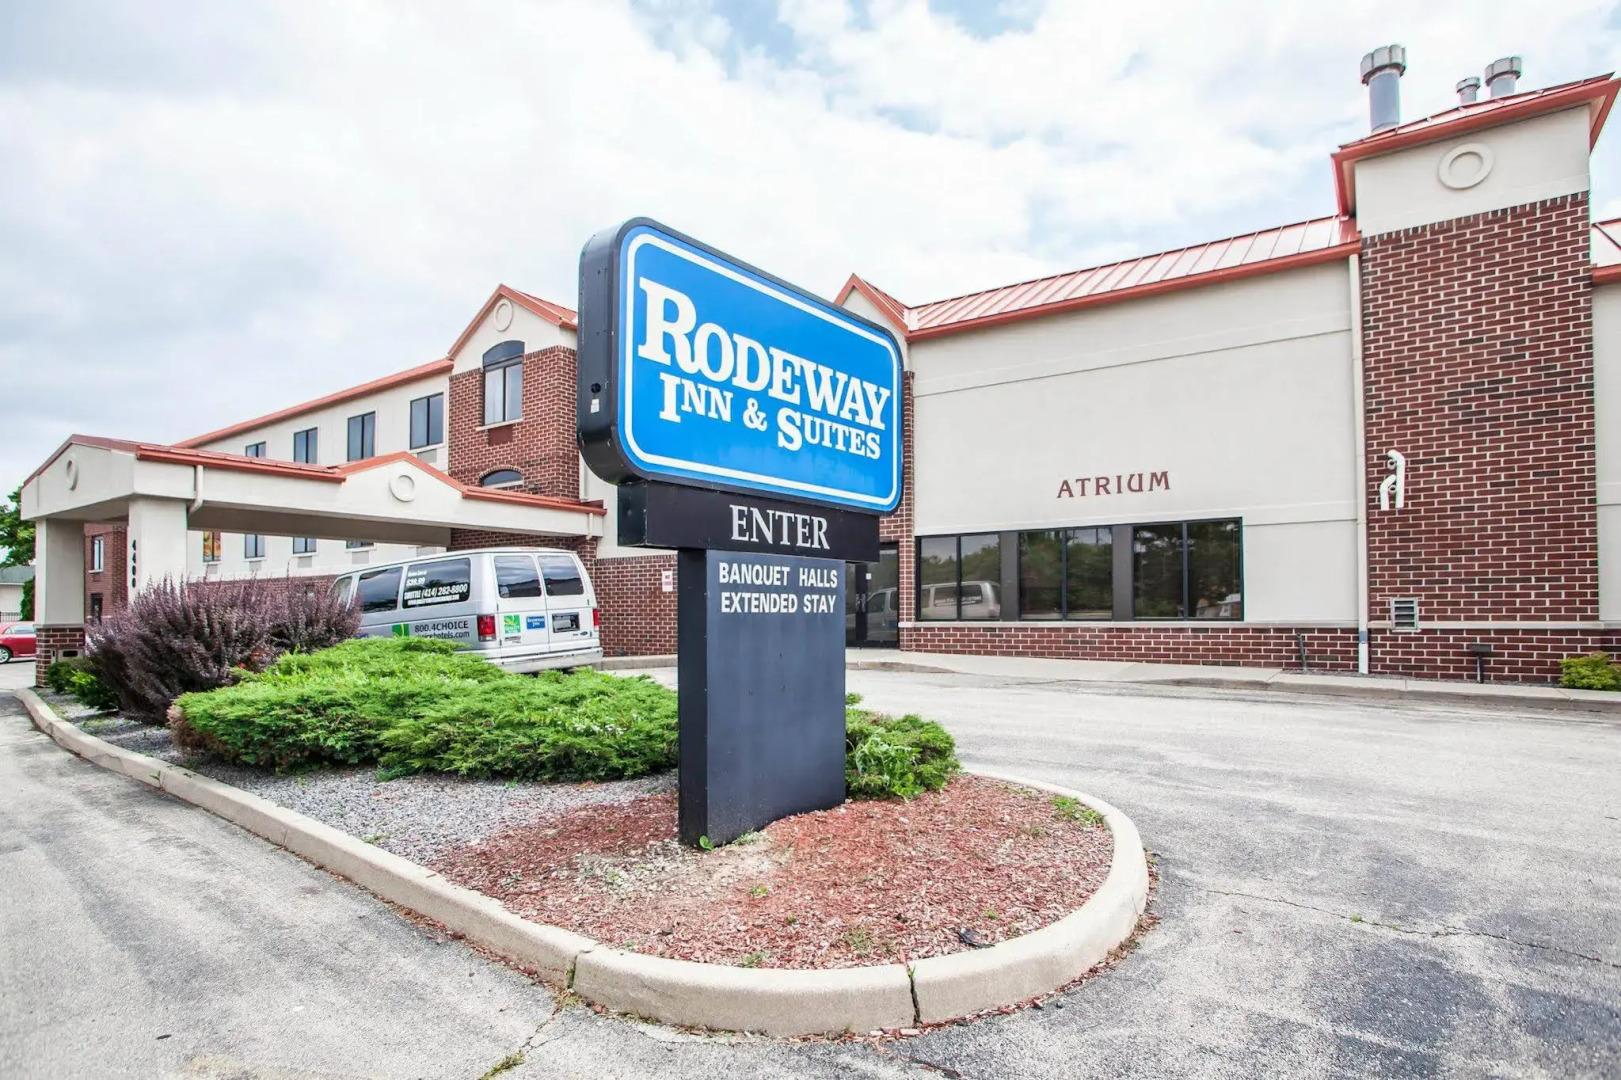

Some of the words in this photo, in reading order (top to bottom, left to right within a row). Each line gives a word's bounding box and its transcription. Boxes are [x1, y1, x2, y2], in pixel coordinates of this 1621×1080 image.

[637, 275, 891, 431] RODEWAY
[659, 372, 733, 423] INN
[743, 397, 768, 431] &
[777, 406, 881, 460] SUITES
[1056, 470, 1171, 499] ATRIUM
[729, 504, 831, 550] ENTER
[719, 562, 791, 586] BANQUET
[799, 566, 838, 588] HALLS
[421, 587, 437, 599] (414)
[721, 592, 799, 613] EXTENDED
[803, 594, 837, 613] STAY
[415, 631, 469, 639] oicehotels.com
